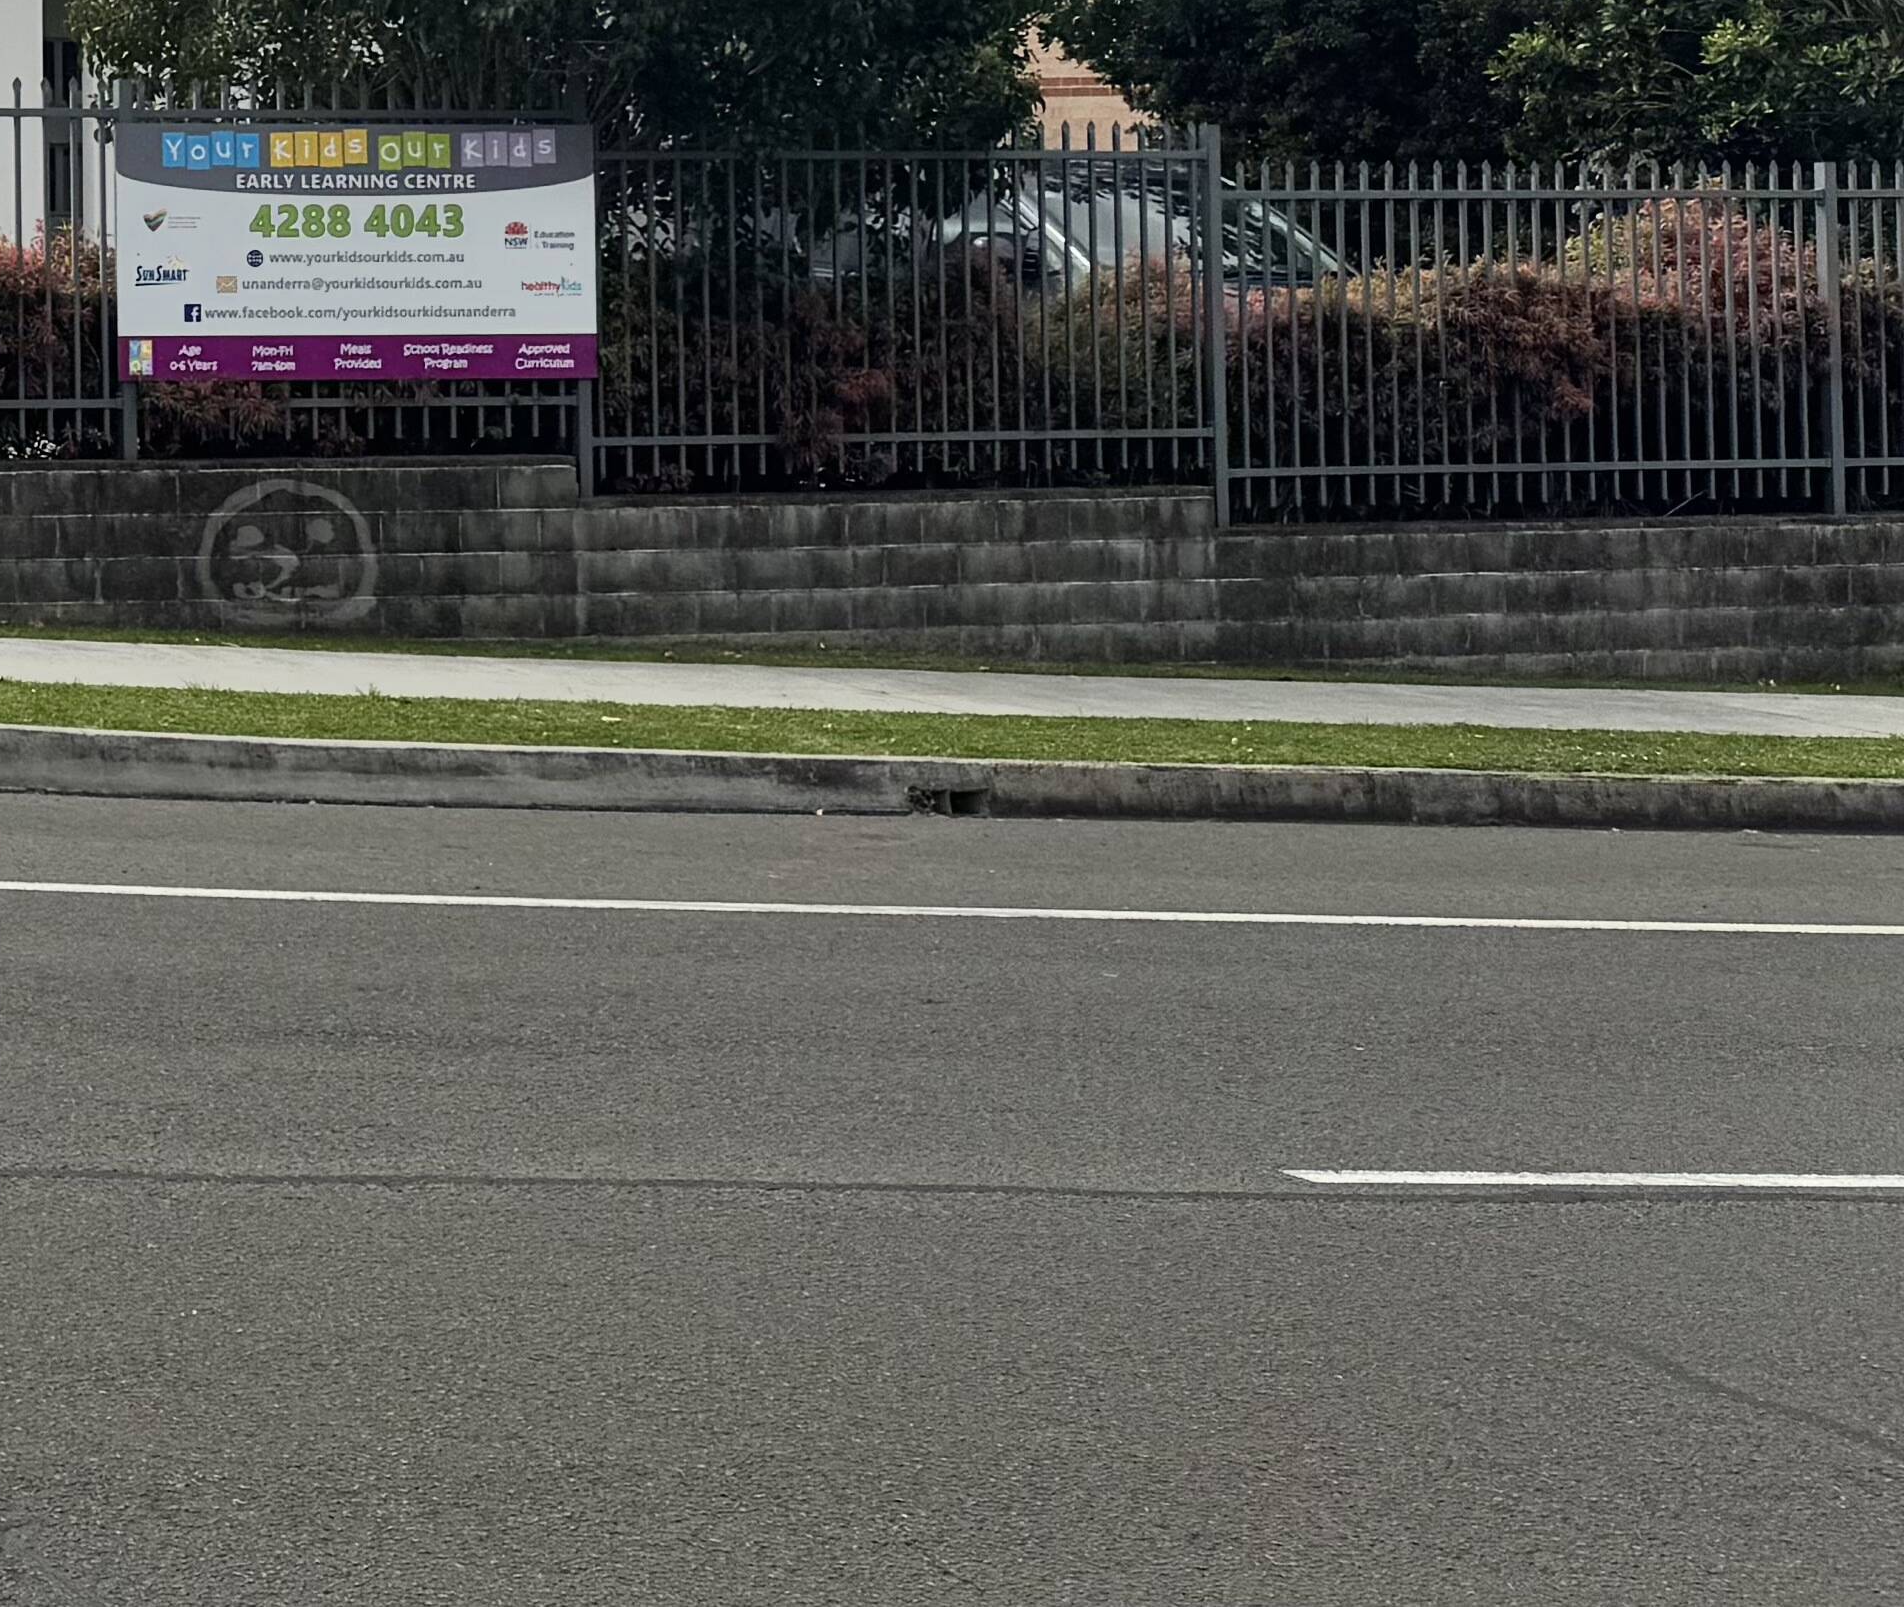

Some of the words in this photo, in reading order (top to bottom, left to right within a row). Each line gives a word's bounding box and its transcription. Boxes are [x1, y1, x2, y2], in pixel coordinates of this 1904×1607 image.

[165, 138, 255, 162] Your
[273, 137, 362, 160] Kids
[464, 137, 553, 160] Kids
[235, 173, 295, 190] EARLY
[301, 173, 398, 190] LEARNING
[404, 173, 476, 190] CENTRE
[248, 203, 352, 239] 4288
[363, 203, 465, 239] 4043
[504, 237, 529, 247] NSW
[269, 250, 465, 266] www.yourkidsourkids.com.au
[242, 276, 483, 293] unanderra@yourkidsourkids.com.au
[205, 305, 517, 322] www.facebook.com/yourkidsourkidsunanderra
[177, 344, 202, 357] Age
[339, 343, 372, 355] Meals
[403, 344, 440, 356] School
[441, 343, 494, 356] Readiness
[518, 343, 571, 356] Approved
[187, 359, 218, 372] Years
[333, 357, 382, 370] Provided
[423, 357, 468, 370] Program
[514, 357, 575, 370] Curriculum
